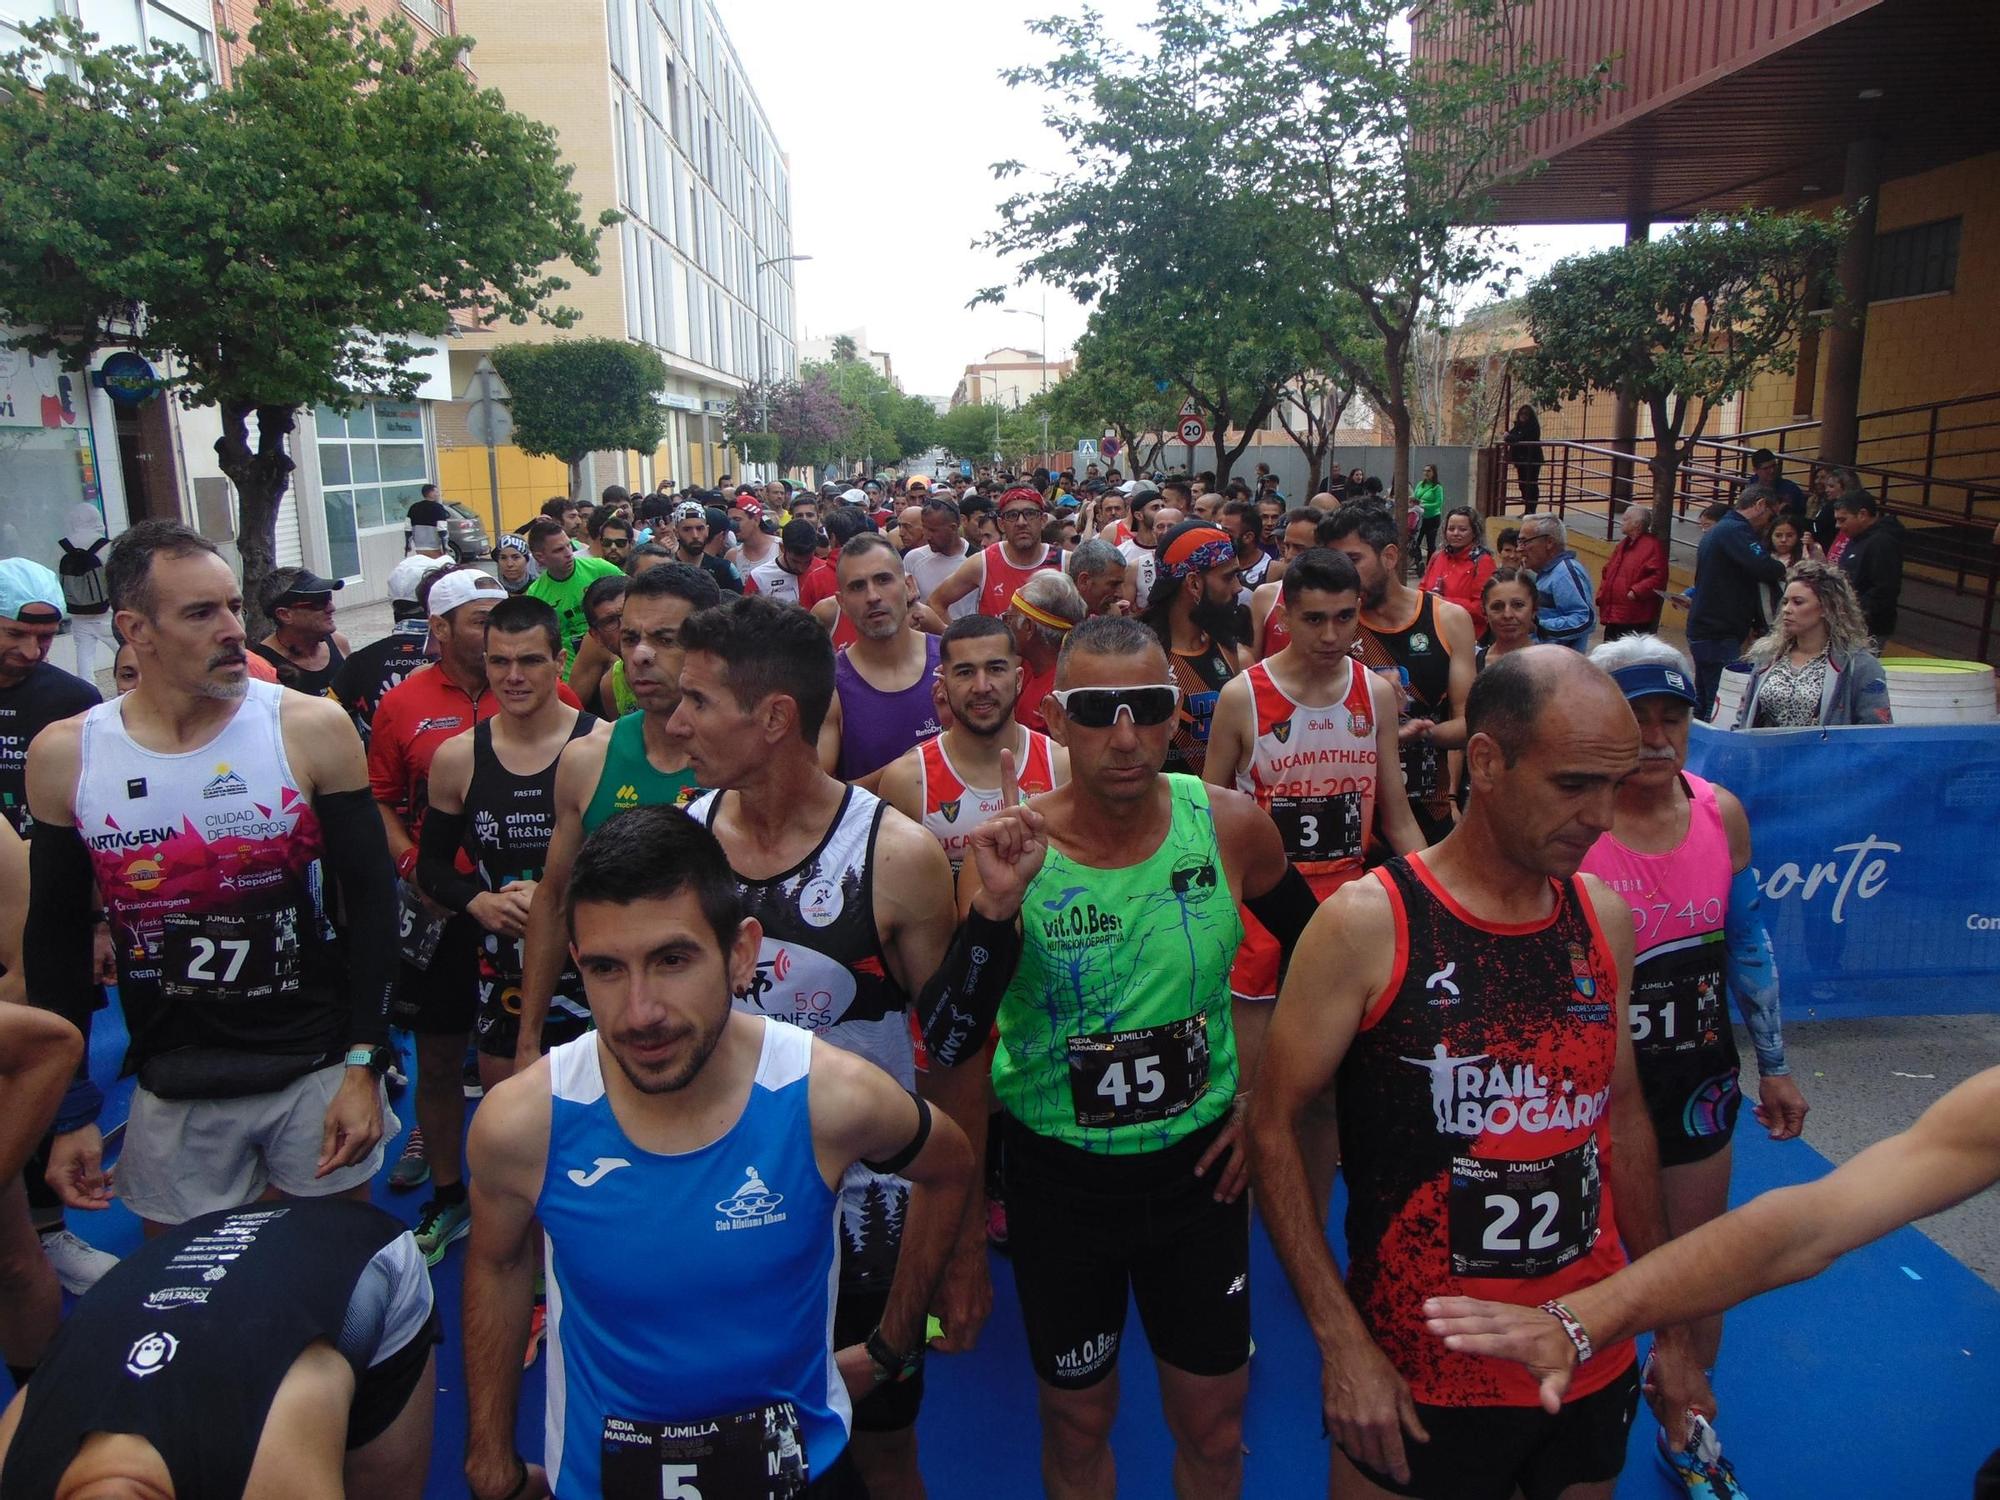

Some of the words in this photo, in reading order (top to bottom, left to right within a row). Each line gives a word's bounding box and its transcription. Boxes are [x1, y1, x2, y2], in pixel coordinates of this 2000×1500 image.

[1183, 425, 1201, 436] 20
[500, 536, 527, 557] Buff
[384, 658, 429, 666] ALFONSO
[1271, 752, 1316, 773] UCAM
[513, 789, 543, 798] FASTER
[205, 810, 255, 827] CIUDAD
[505, 813, 545, 824] alma
[226, 821, 288, 838] TESOROS
[1300, 815, 1320, 848] 3
[238, 873, 283, 888] Deportes
[206, 914, 246, 924] JUMILLA
[187, 937, 251, 982] 27
[1640, 980, 1674, 991] JUMILLA
[1629, 1002, 1677, 1041] 51
[1111, 1030, 1154, 1043] JUMILLA
[1097, 1055, 1166, 1107] 45
[1453, 1157, 1481, 1169] MEDIA
[1506, 1159, 1555, 1173] JUMILLA
[1453, 1167, 1498, 1179] MARATÓN
[716, 1220, 731, 1232] Club
[1482, 1191, 1560, 1251] 22
[607, 1418, 635, 1433] MEDIA
[661, 1422, 719, 1439] JUMILLA
[604, 1430, 652, 1445] MARATÓN
[661, 1464, 704, 1500] 5
